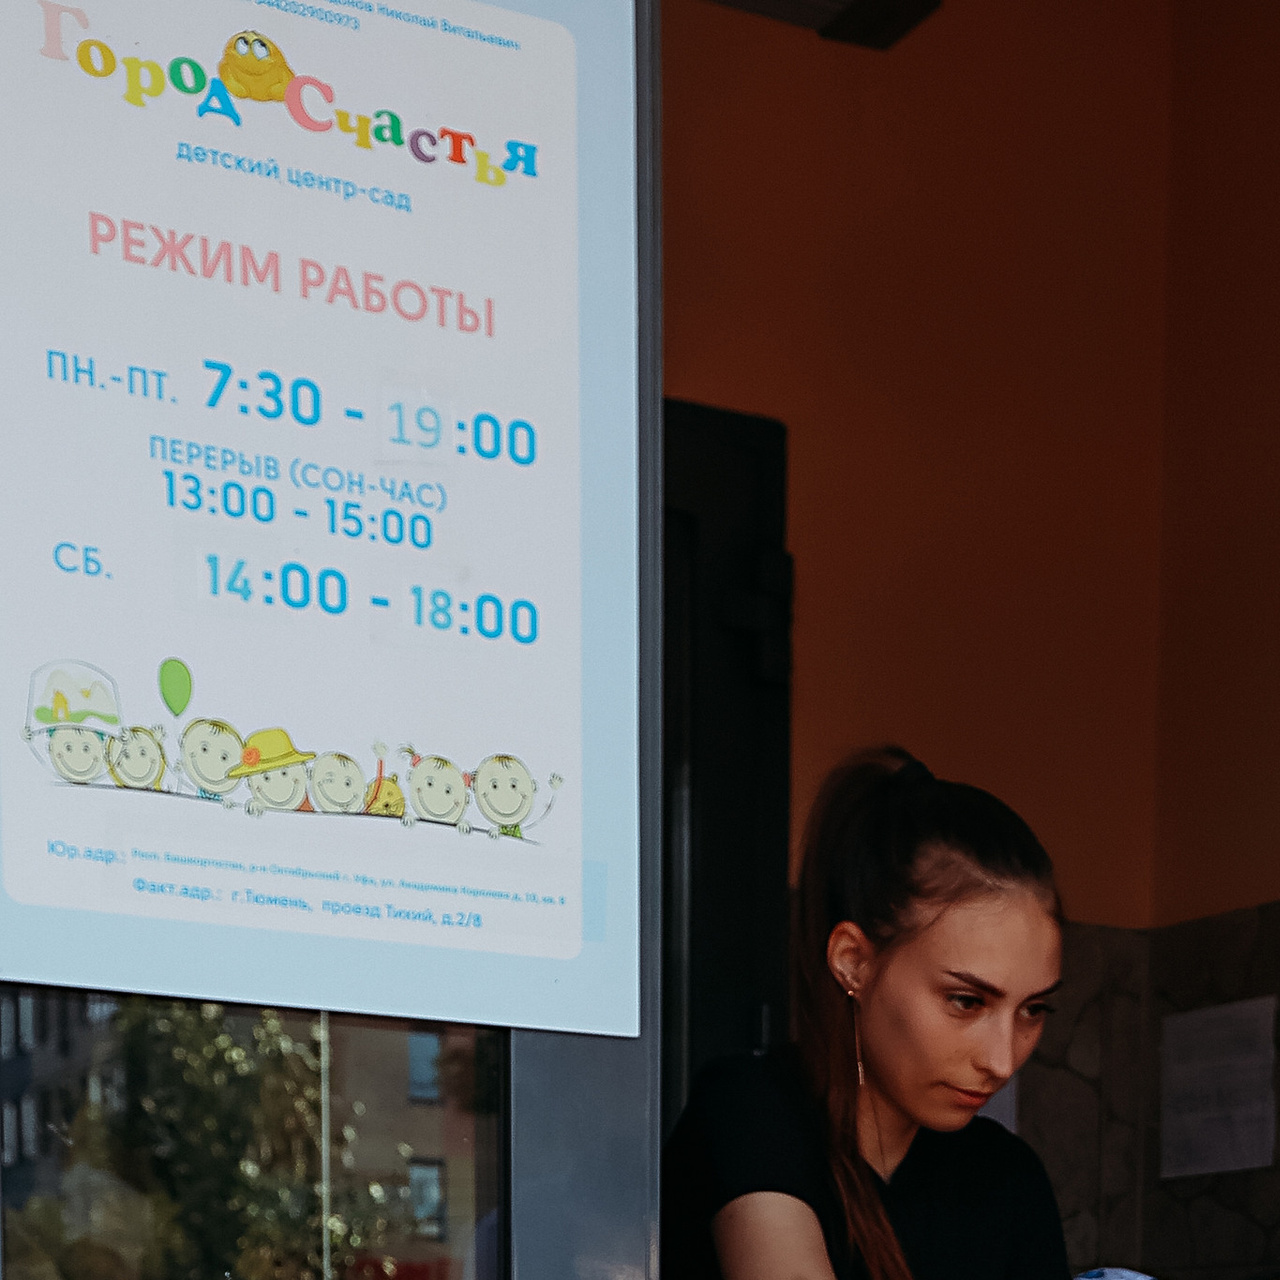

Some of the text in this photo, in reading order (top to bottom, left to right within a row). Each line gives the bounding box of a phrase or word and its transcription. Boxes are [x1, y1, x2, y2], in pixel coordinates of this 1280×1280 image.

[284, 75, 539, 187] Счастья
[176, 142, 413, 213] детский центр-сад
[87, 211, 496, 337] РЕЖИМ РАБОТЫ
[202, 359, 323, 427] 7:30
[149, 434, 449, 513] ПЕРЕРЫВ (СОН-ЧАС)
[163, 469, 276, 524] 13:00
[324, 497, 434, 549] 15:00
[53, 541, 113, 579] СБ.
[205, 553, 348, 616] 14:00
[409, 583, 541, 646] 18:00
[321, 899, 382, 919] проезд
